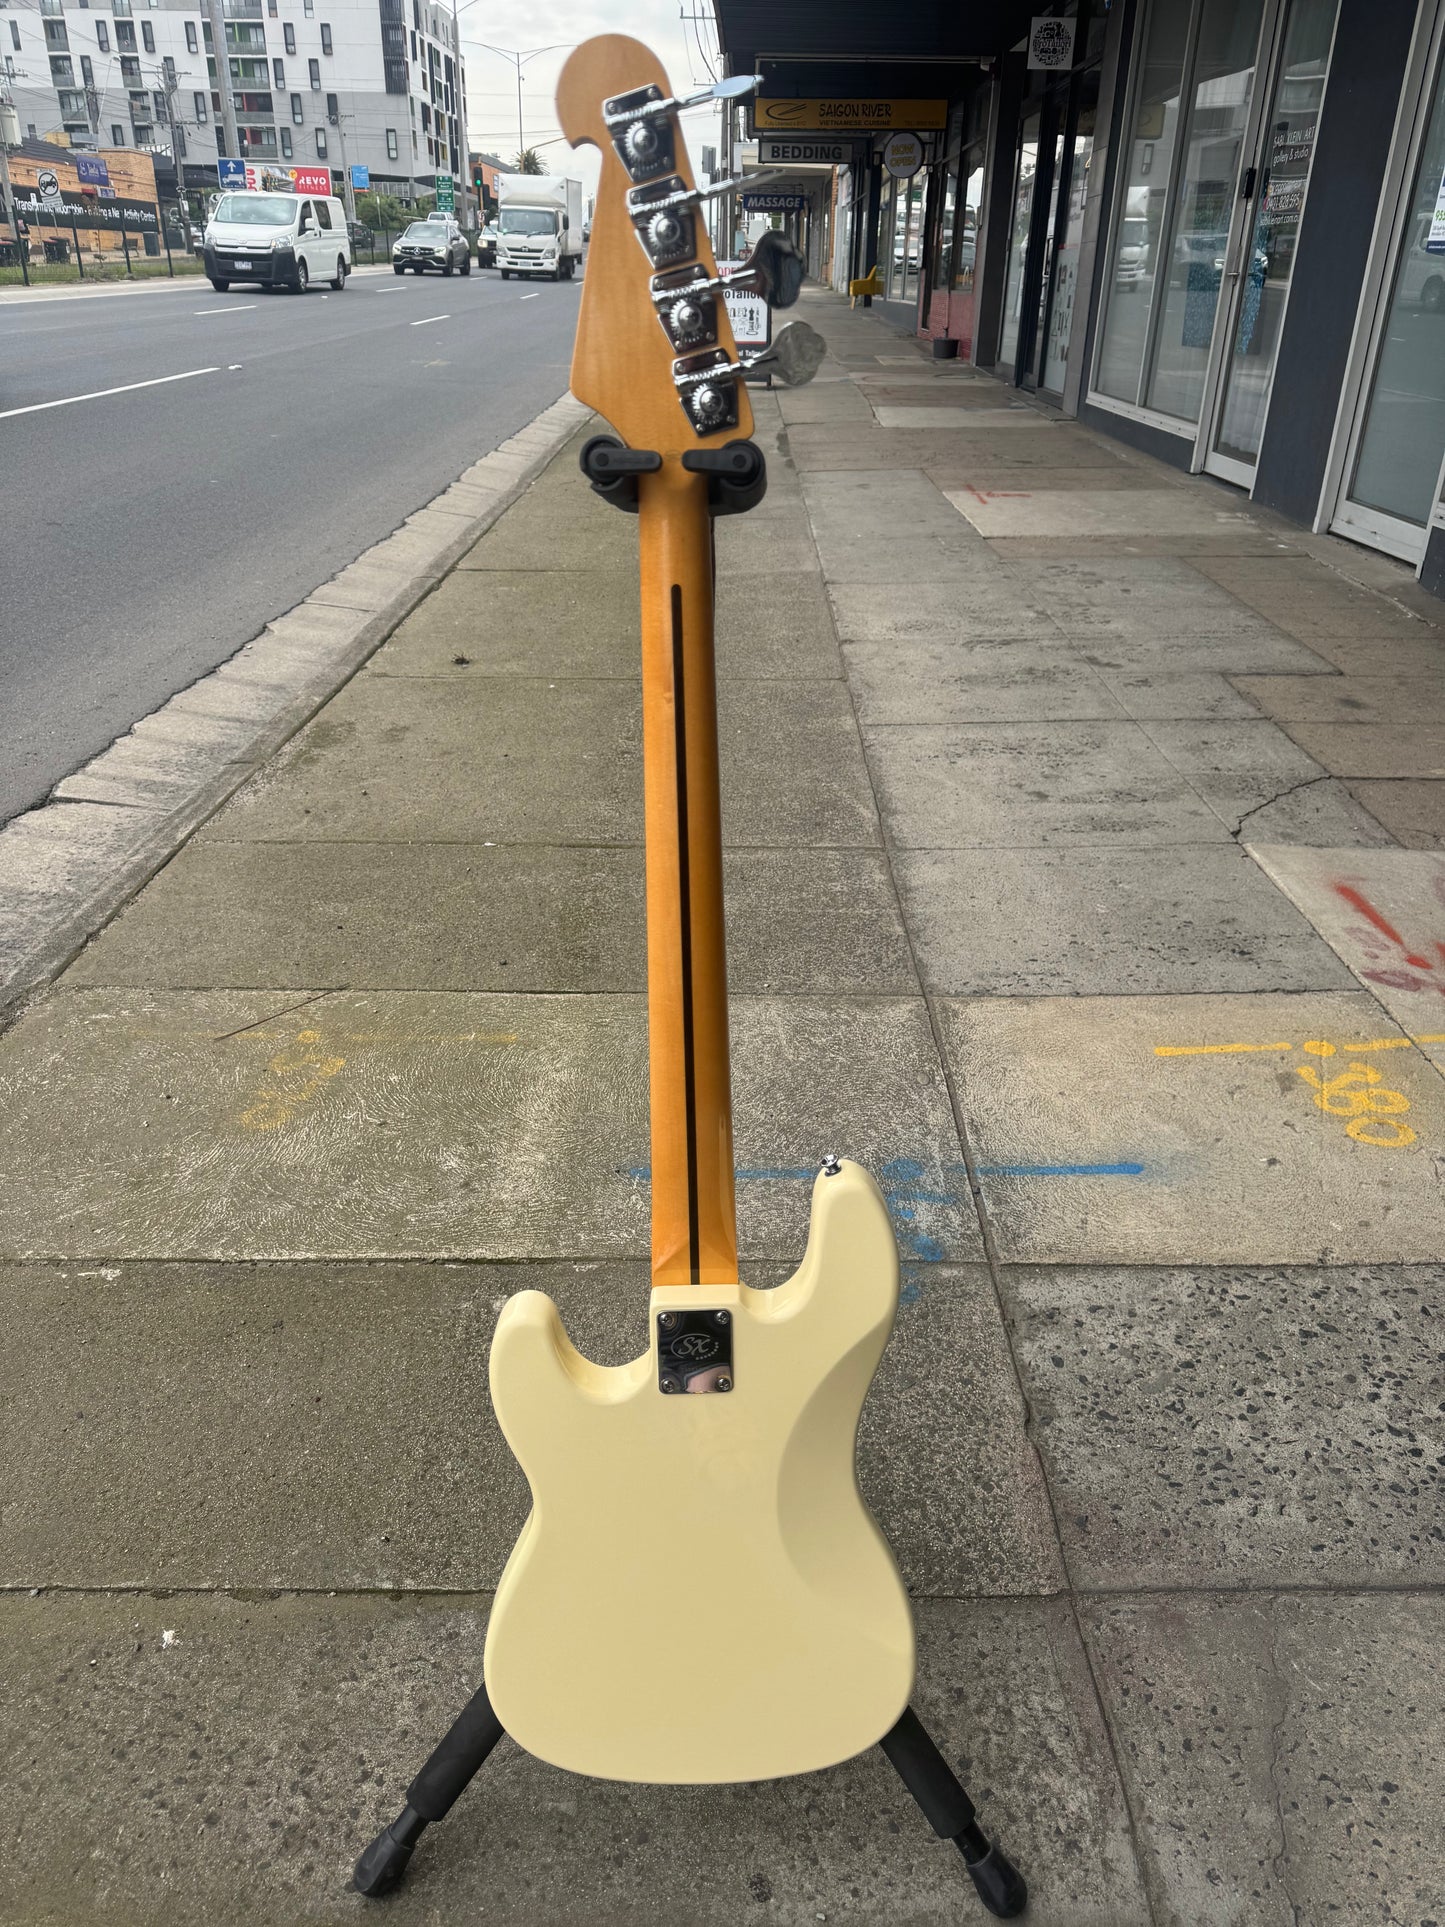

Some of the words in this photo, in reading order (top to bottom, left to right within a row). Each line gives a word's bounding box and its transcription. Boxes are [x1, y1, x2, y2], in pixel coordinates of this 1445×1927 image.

[819, 103, 860, 117] SAIGON
[862, 103, 892, 117] RIVER
[771, 146, 842, 160] BEDDING
[299, 176, 327, 185] REVO
[747, 197, 801, 208] MASSAGE
